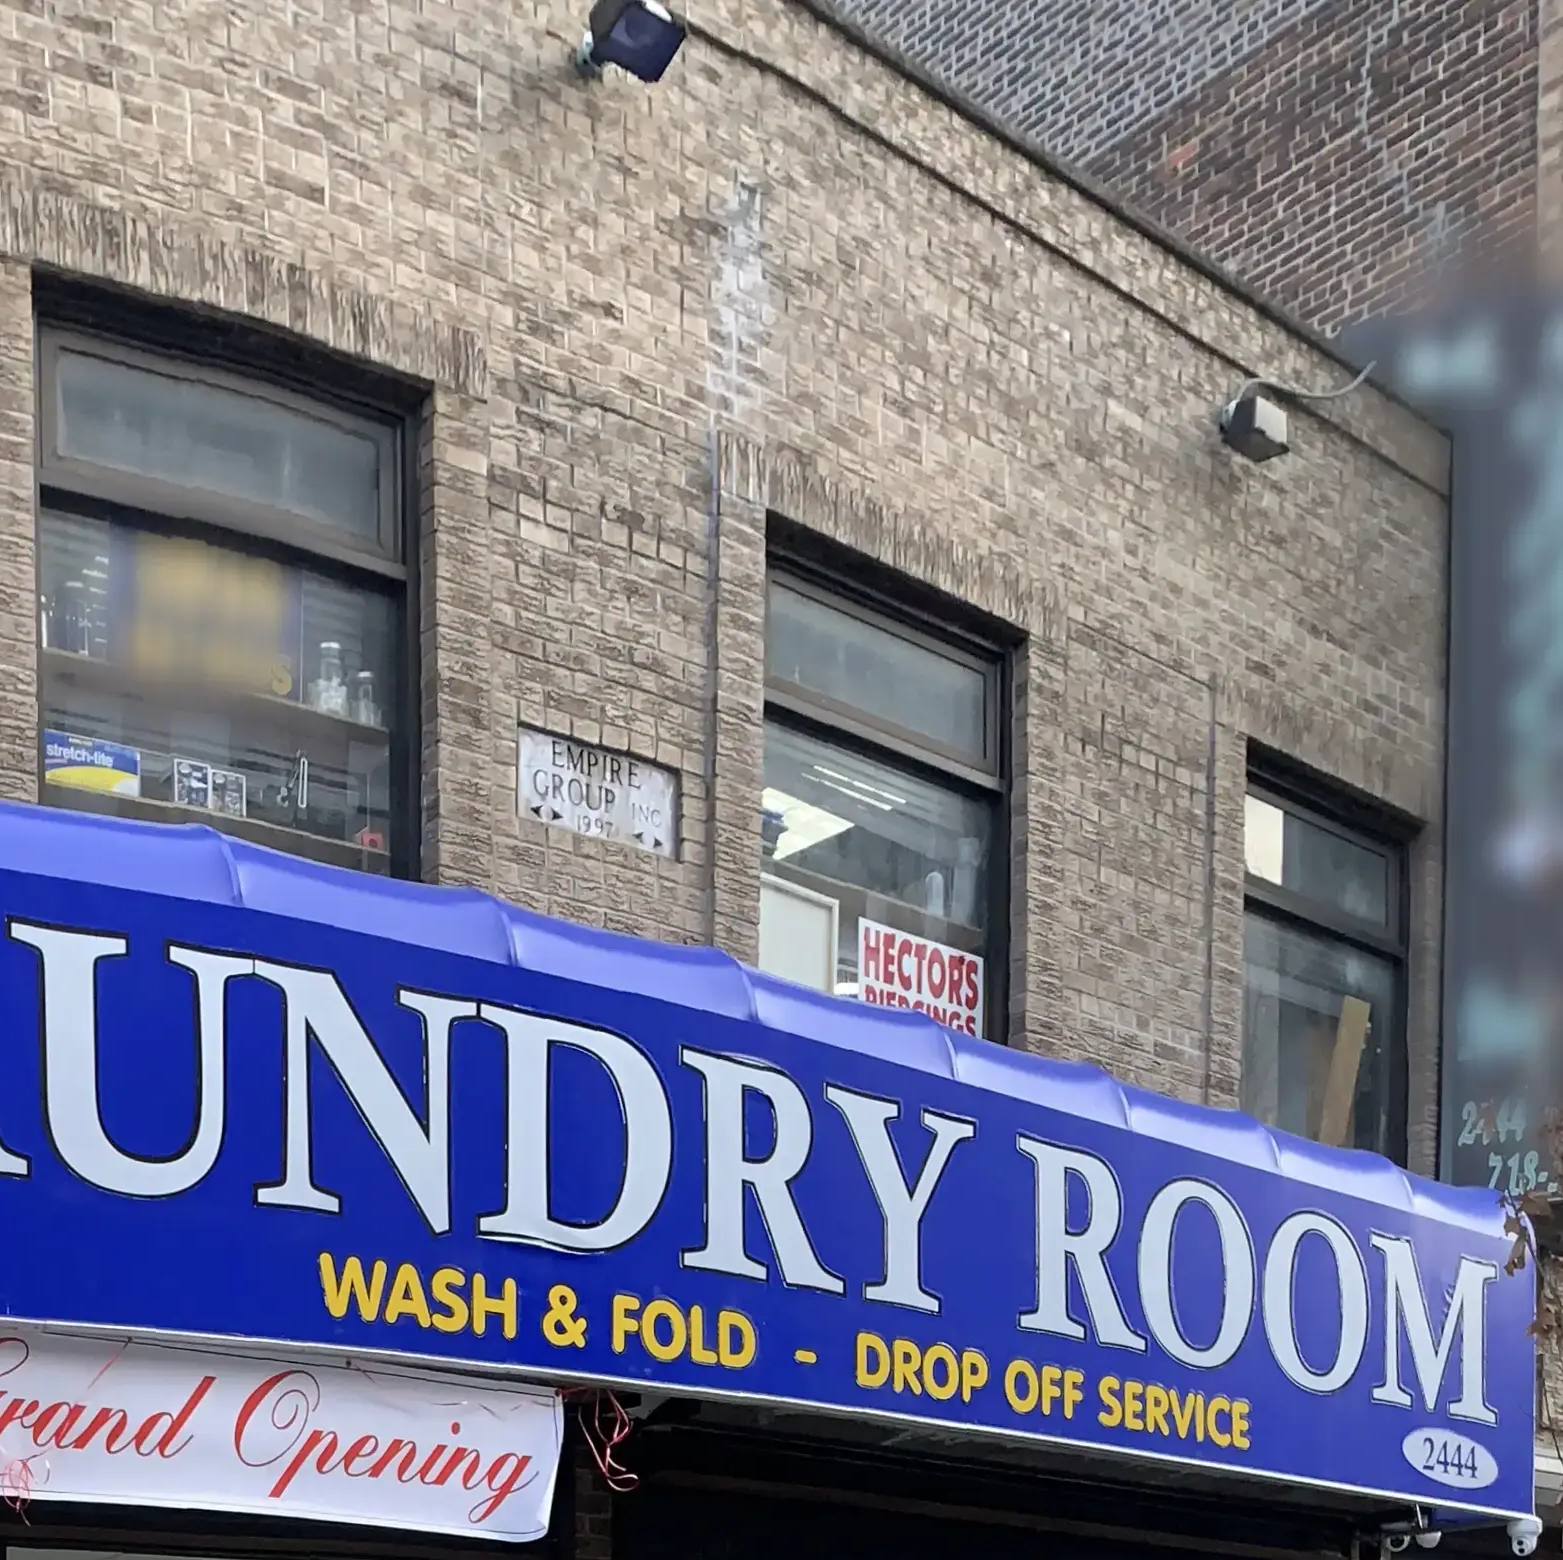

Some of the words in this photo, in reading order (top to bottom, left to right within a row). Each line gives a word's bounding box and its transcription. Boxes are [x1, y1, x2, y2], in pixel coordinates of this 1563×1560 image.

[551, 740, 641, 790] EMPIRE
[533, 769, 617, 813] GROUP
[631, 802, 662, 828] INC
[577, 815, 614, 838] 1997
[1016, 1134, 1500, 1428] ROOM
[318, 1252, 518, 1340] WASH
[542, 1284, 586, 1349] &
[611, 1293, 756, 1368] FOLD
[855, 1332, 989, 1403] DROP
[1004, 1359, 1084, 1420] OFF
[1097, 1375, 1251, 1450] SERVICE
[233, 1368, 539, 1524] Opening
[1422, 1437, 1478, 1479] 2444
